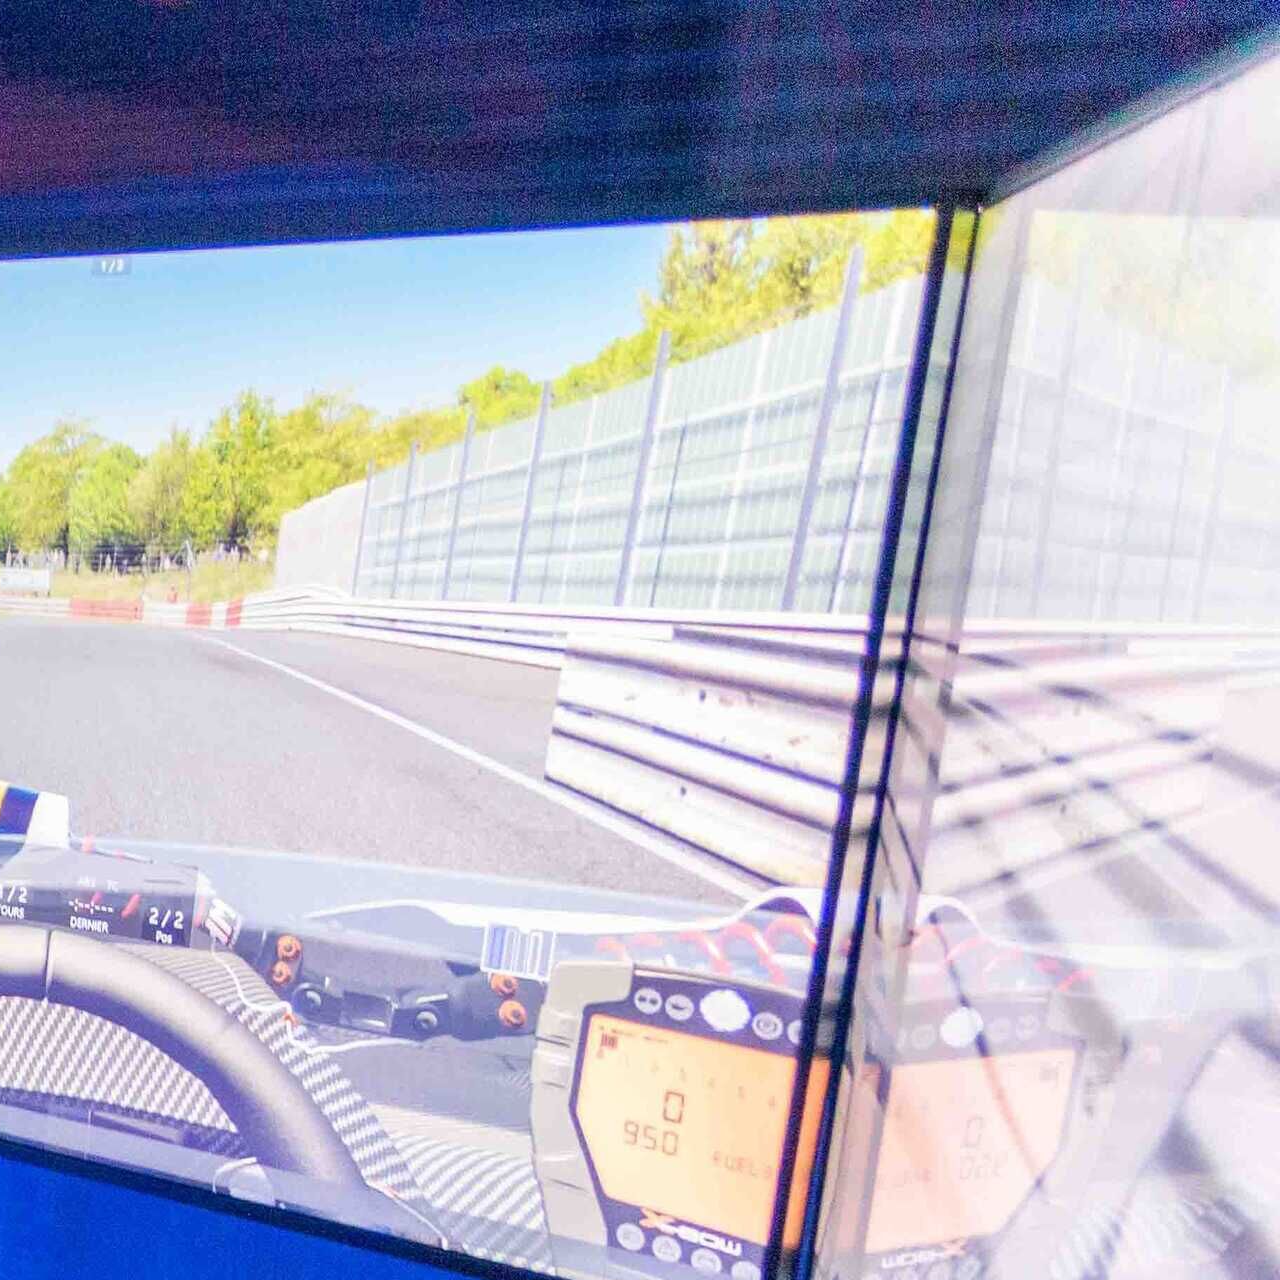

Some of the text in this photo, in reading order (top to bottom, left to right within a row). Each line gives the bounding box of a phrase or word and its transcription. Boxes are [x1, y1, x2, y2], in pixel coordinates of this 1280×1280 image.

[69, 915, 109, 933] DERNIER
[155, 930, 173, 944] Pos
[663, 1091, 685, 1124] 0
[623, 1120, 679, 1156] 950
